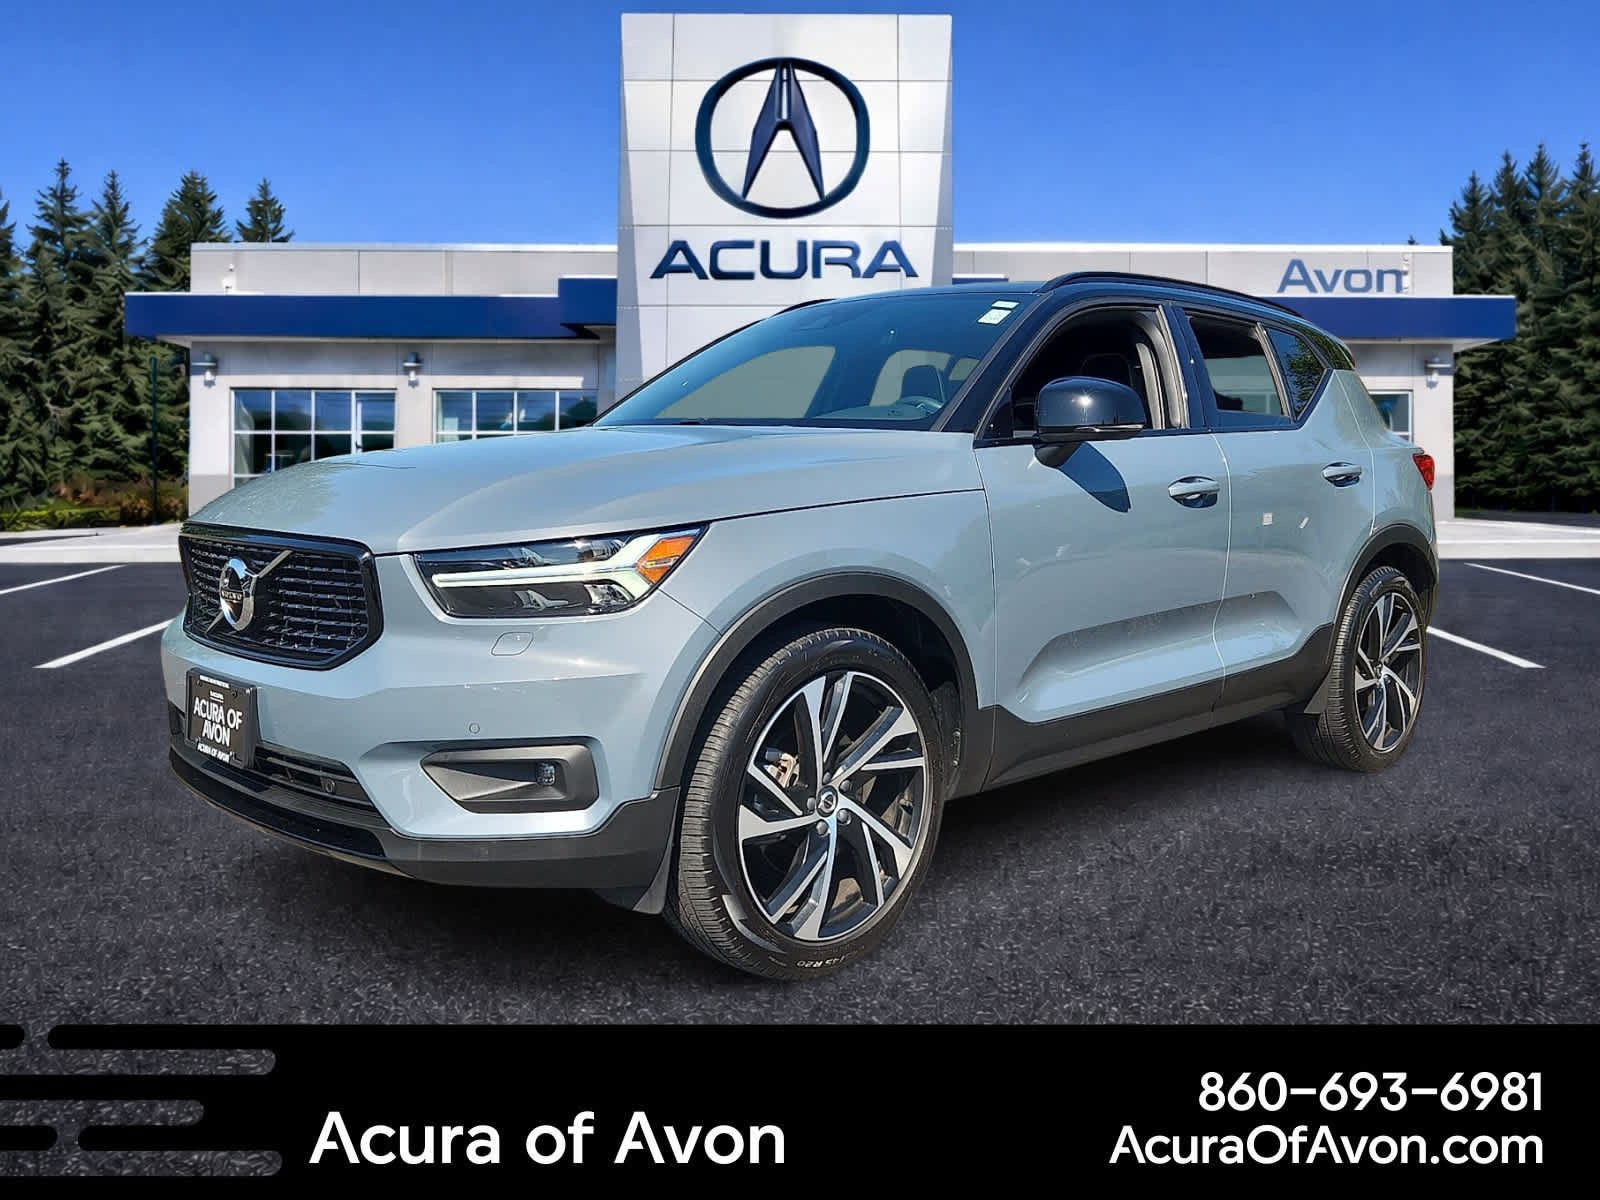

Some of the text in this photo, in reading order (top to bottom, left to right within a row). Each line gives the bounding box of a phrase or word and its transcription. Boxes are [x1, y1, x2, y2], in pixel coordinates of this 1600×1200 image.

[650, 239, 919, 280] ACURA
[1277, 258, 1404, 293] Avon
[193, 697, 243, 730] ACURA OF
[202, 719, 231, 747] AVON
